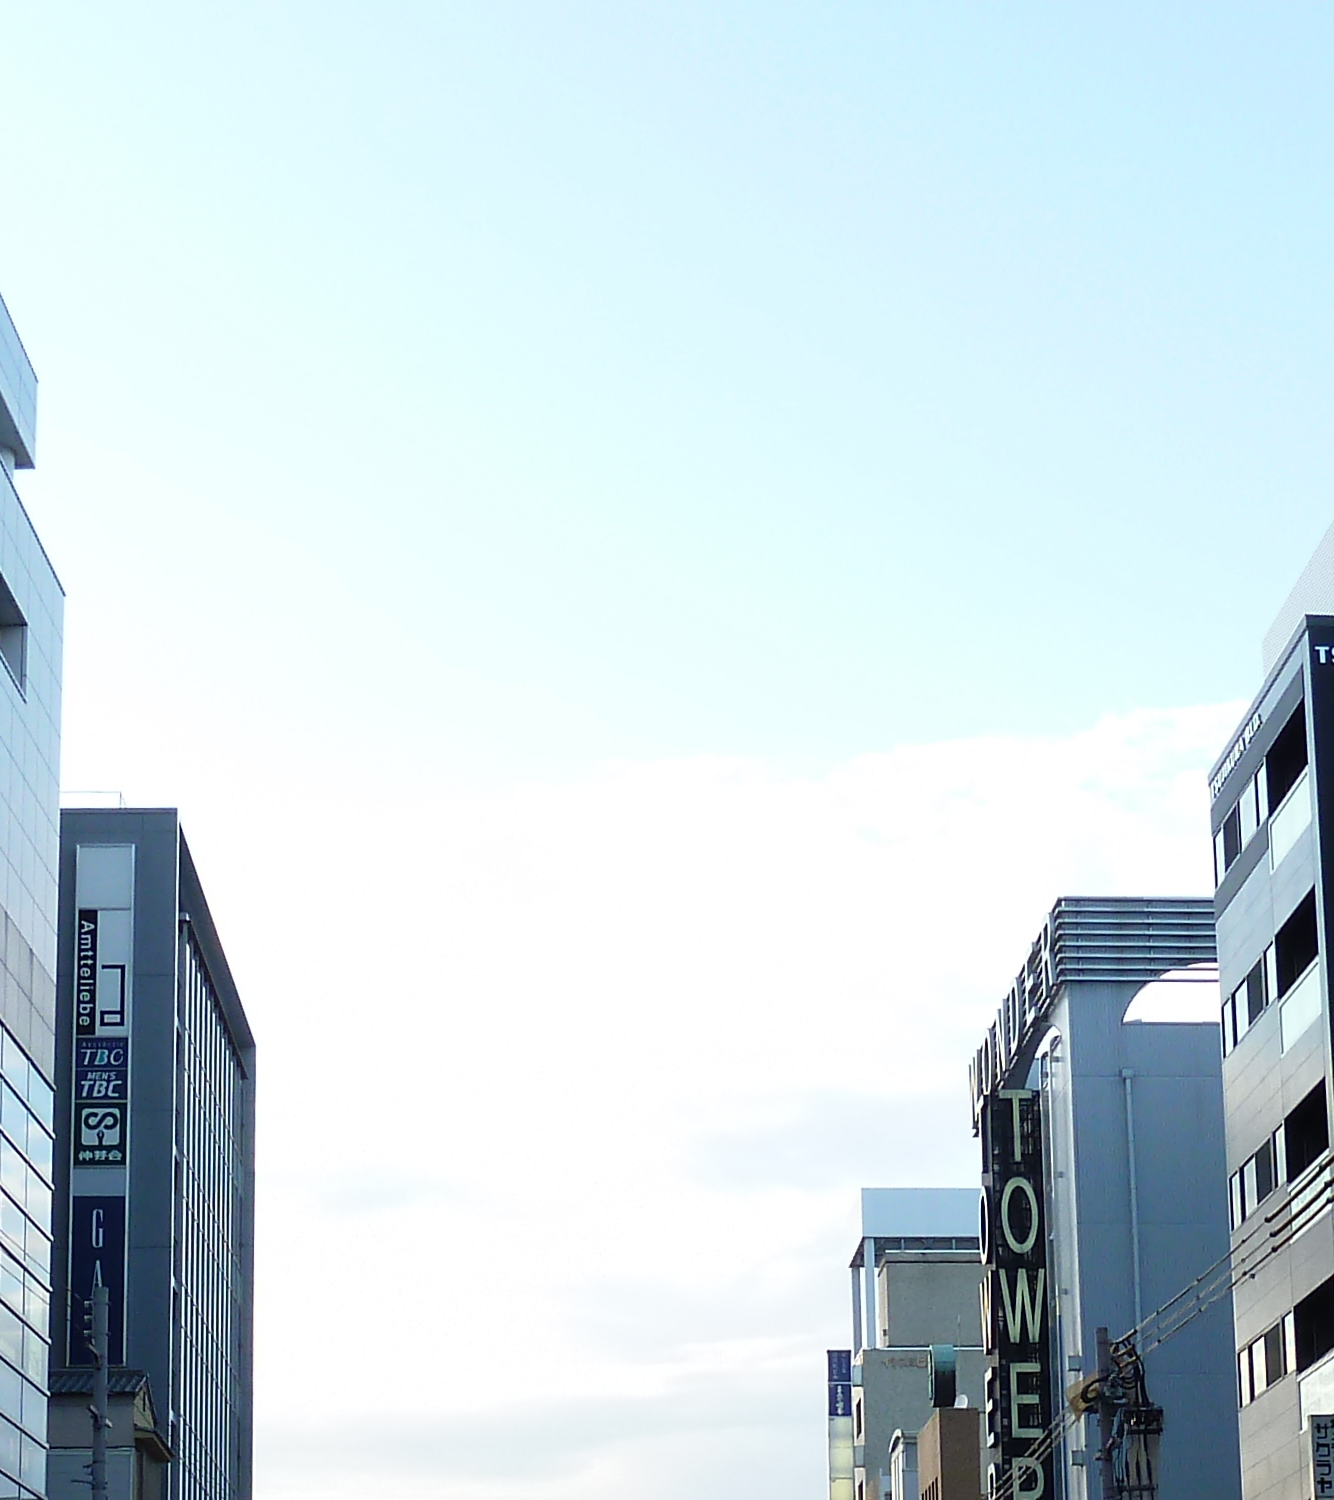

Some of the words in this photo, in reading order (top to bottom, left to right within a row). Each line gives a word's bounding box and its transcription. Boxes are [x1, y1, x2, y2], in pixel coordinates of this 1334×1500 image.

[80, 1048, 124, 1066] TBC
[80, 1080, 123, 1097] TBC
[1314, 1422, 1334, 1494] サクラヤ
